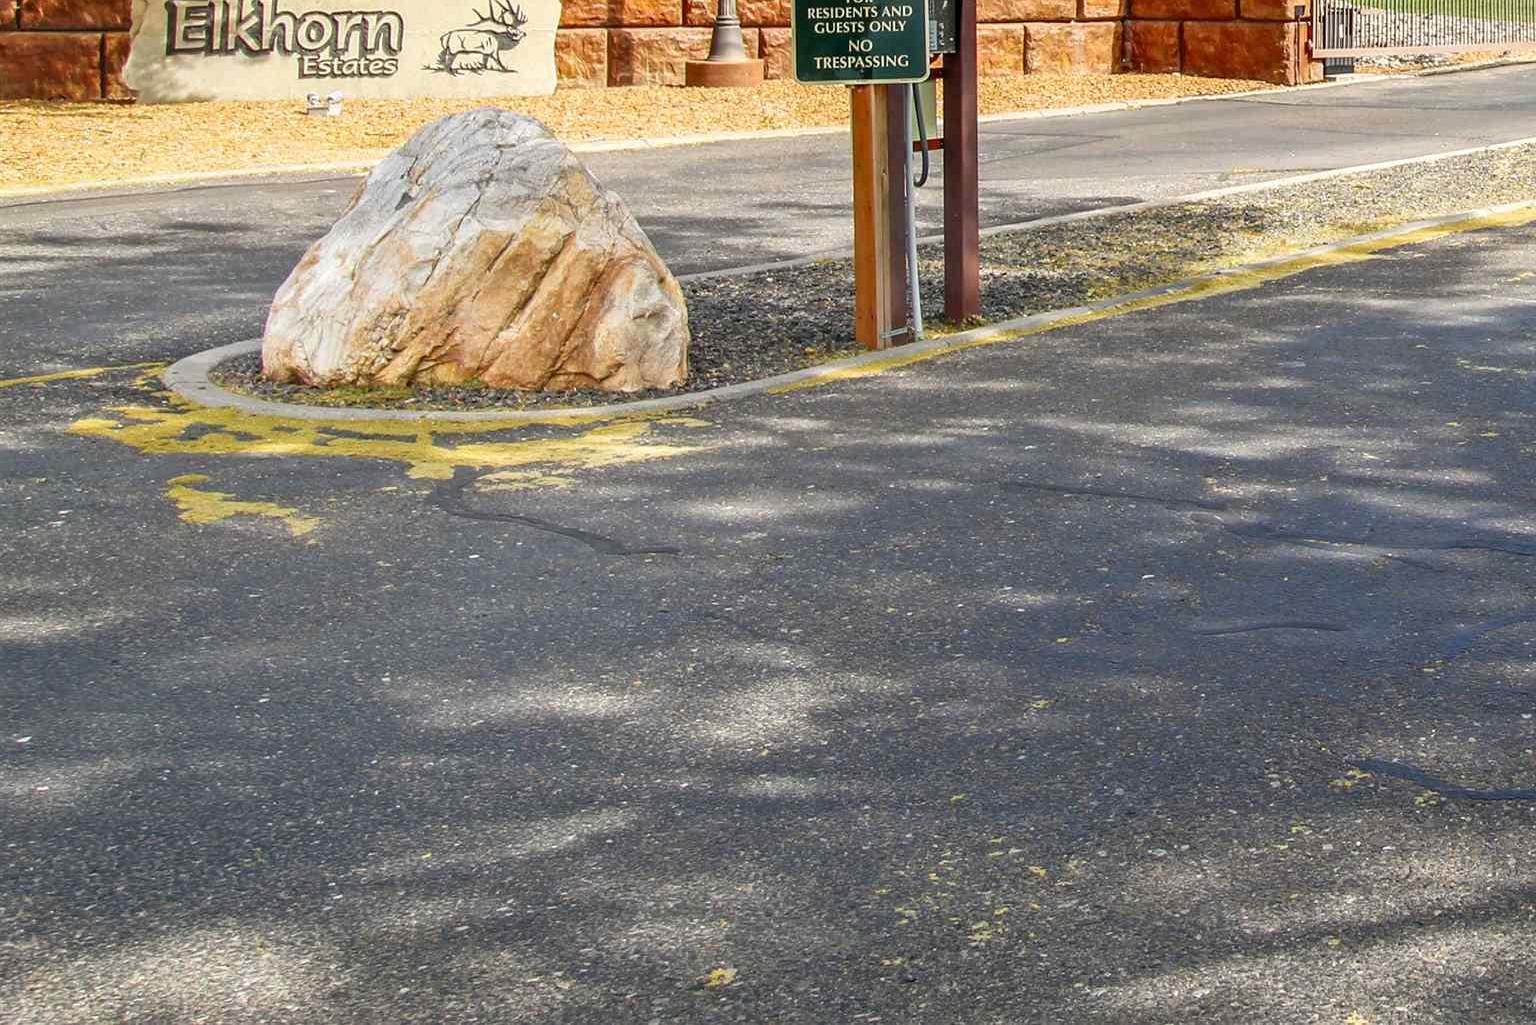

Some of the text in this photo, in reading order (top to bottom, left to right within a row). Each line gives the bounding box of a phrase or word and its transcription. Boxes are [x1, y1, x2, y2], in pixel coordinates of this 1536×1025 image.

[807, 5, 913, 20] RESIDENTS AND
[814, 20, 907, 34] GUESTS ONLY
[848, 39, 873, 53] NO
[300, 54, 400, 79] Estates
[814, 54, 910, 70] TRESPASSING
